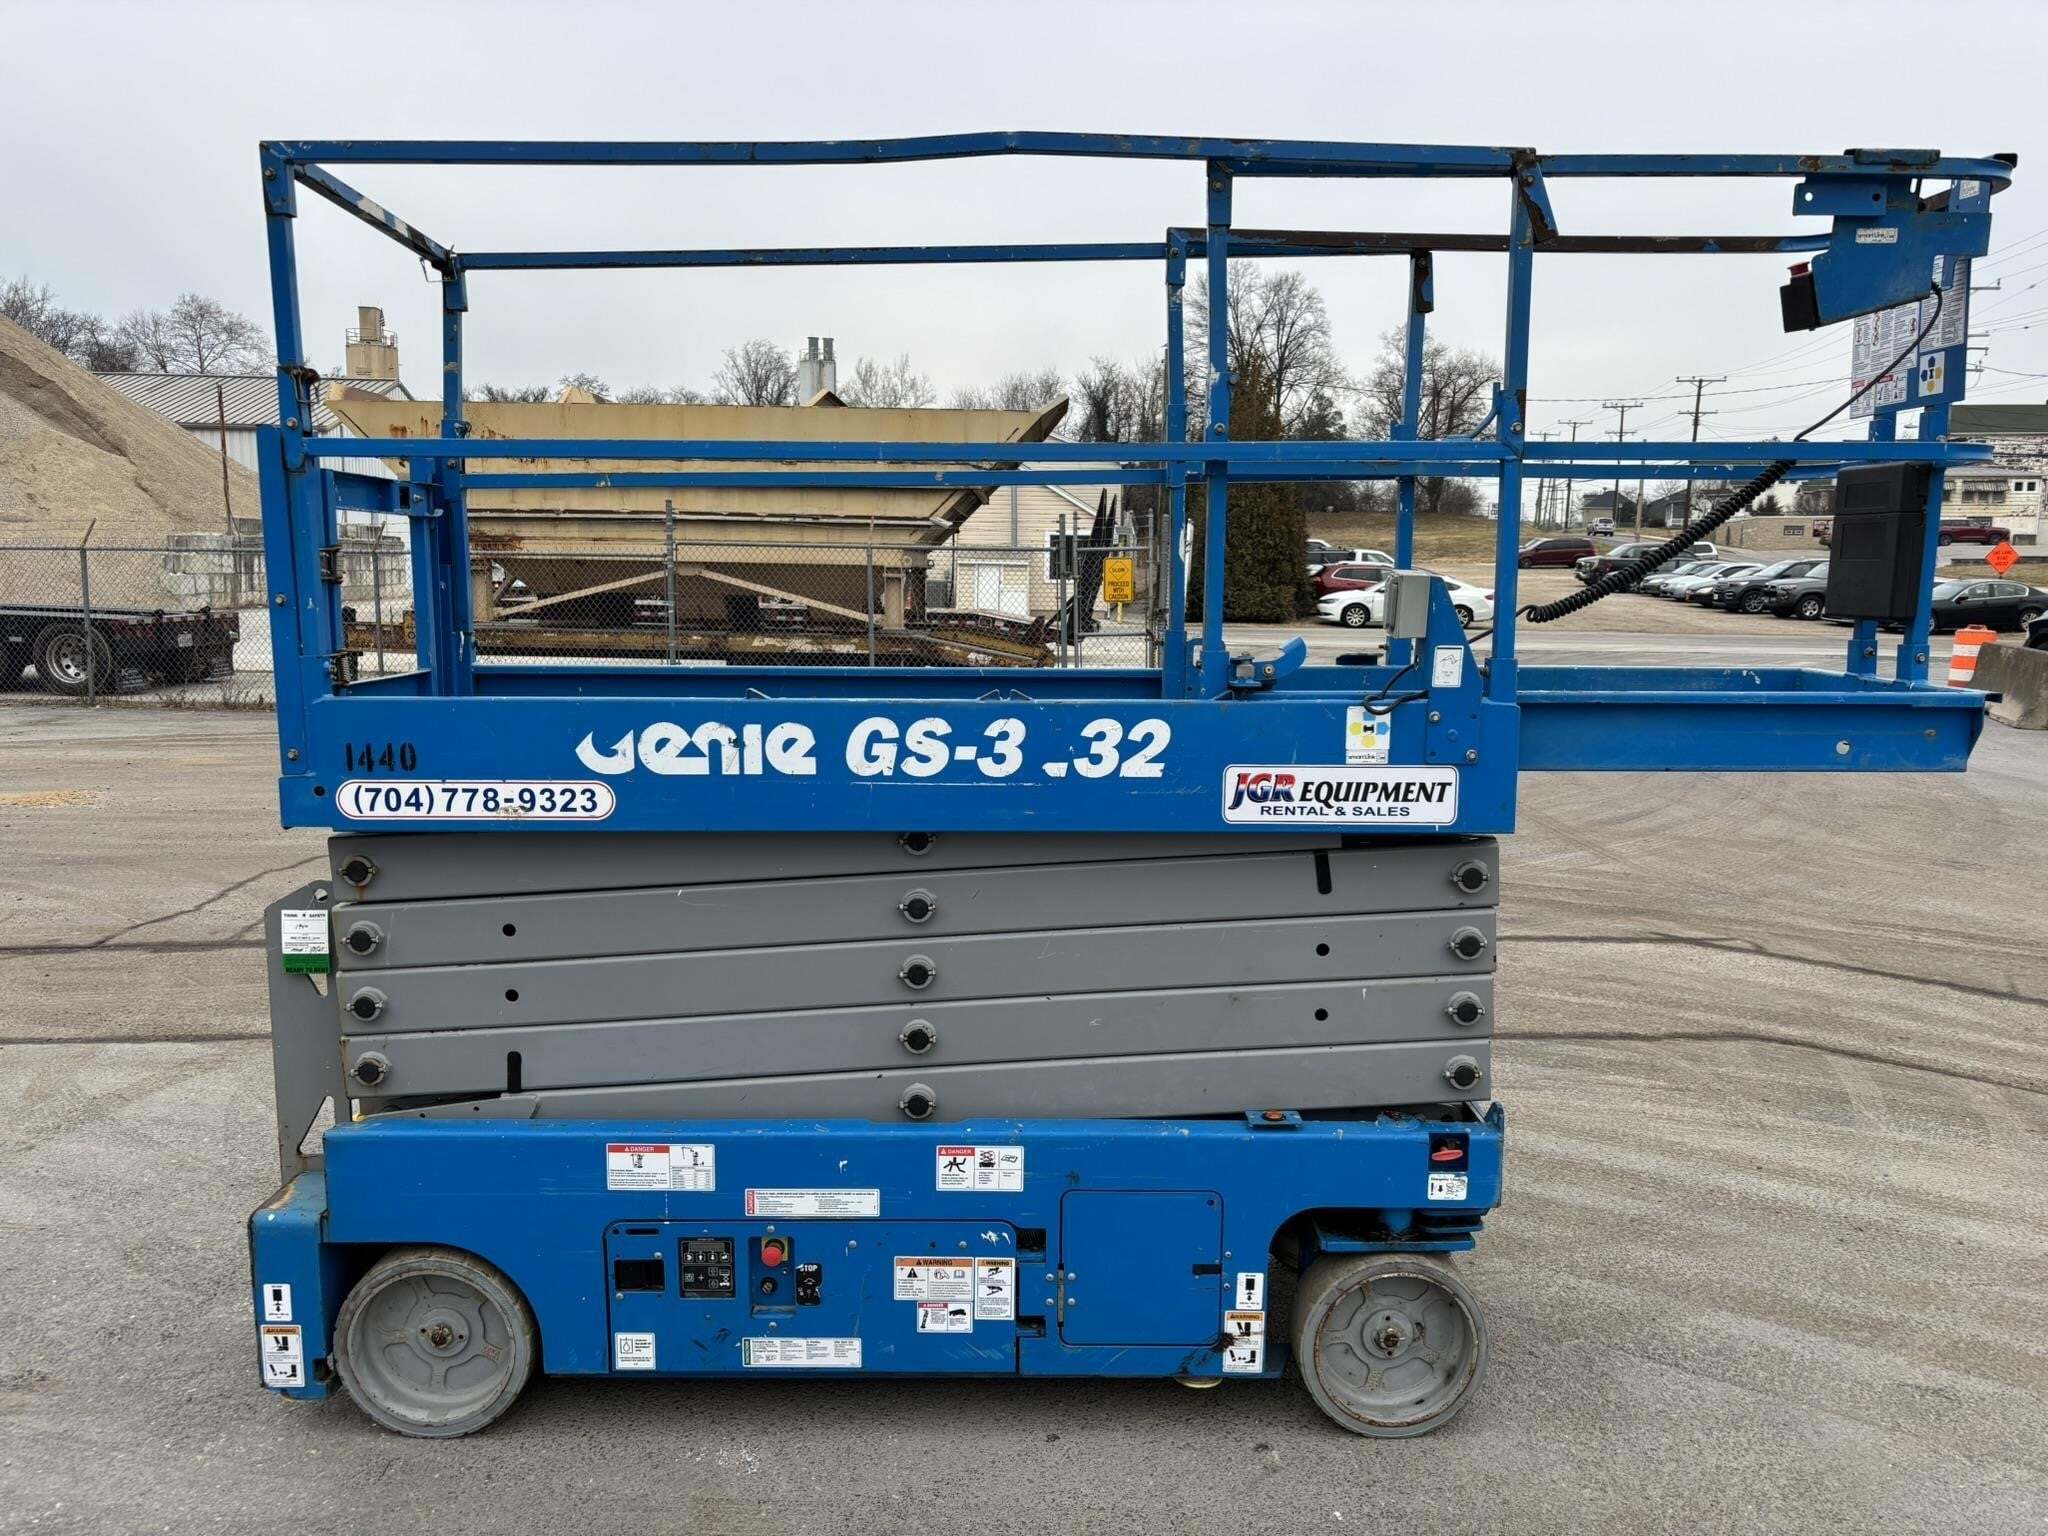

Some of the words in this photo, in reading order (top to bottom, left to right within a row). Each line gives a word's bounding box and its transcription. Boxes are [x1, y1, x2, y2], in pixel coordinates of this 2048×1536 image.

[345, 742, 417, 772] 1440
[575, 721, 817, 775] Genie
[1228, 772, 1296, 810] JGR
[1300, 780, 1453, 809] EQUIPMENT
[1260, 806, 1329, 816] RENTAL
[1334, 806, 1346, 816] &
[1352, 806, 1411, 817] SALES
